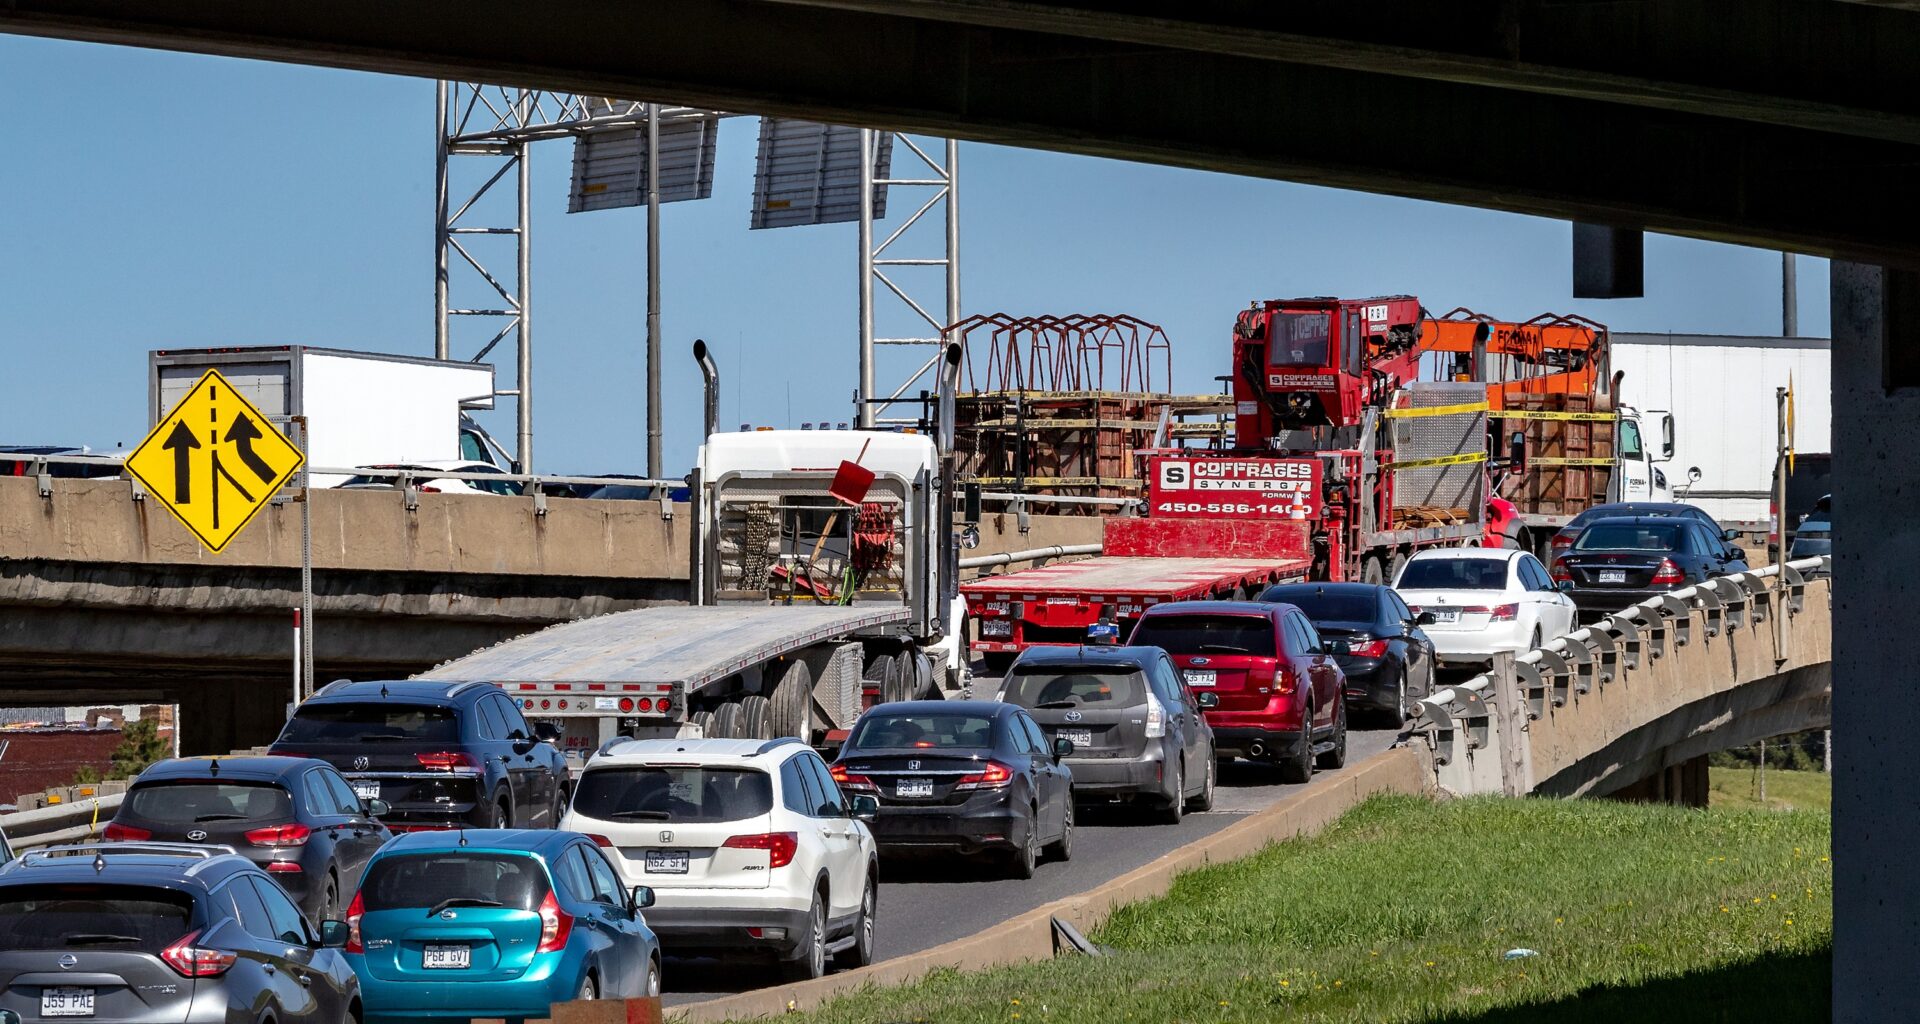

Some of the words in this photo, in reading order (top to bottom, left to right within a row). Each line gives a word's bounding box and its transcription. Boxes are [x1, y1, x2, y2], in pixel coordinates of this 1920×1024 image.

[1166, 467, 1185, 483] S
[1193, 462, 1312, 478] COFFRAGES
[1200, 480, 1304, 489] SYNERGY
[648, 858, 665, 868] N62
[670, 858, 687, 868] SFW
[450, 950, 469, 962] GVT
[44, 994, 65, 1008] J59
[72, 995, 93, 1008] PAE
